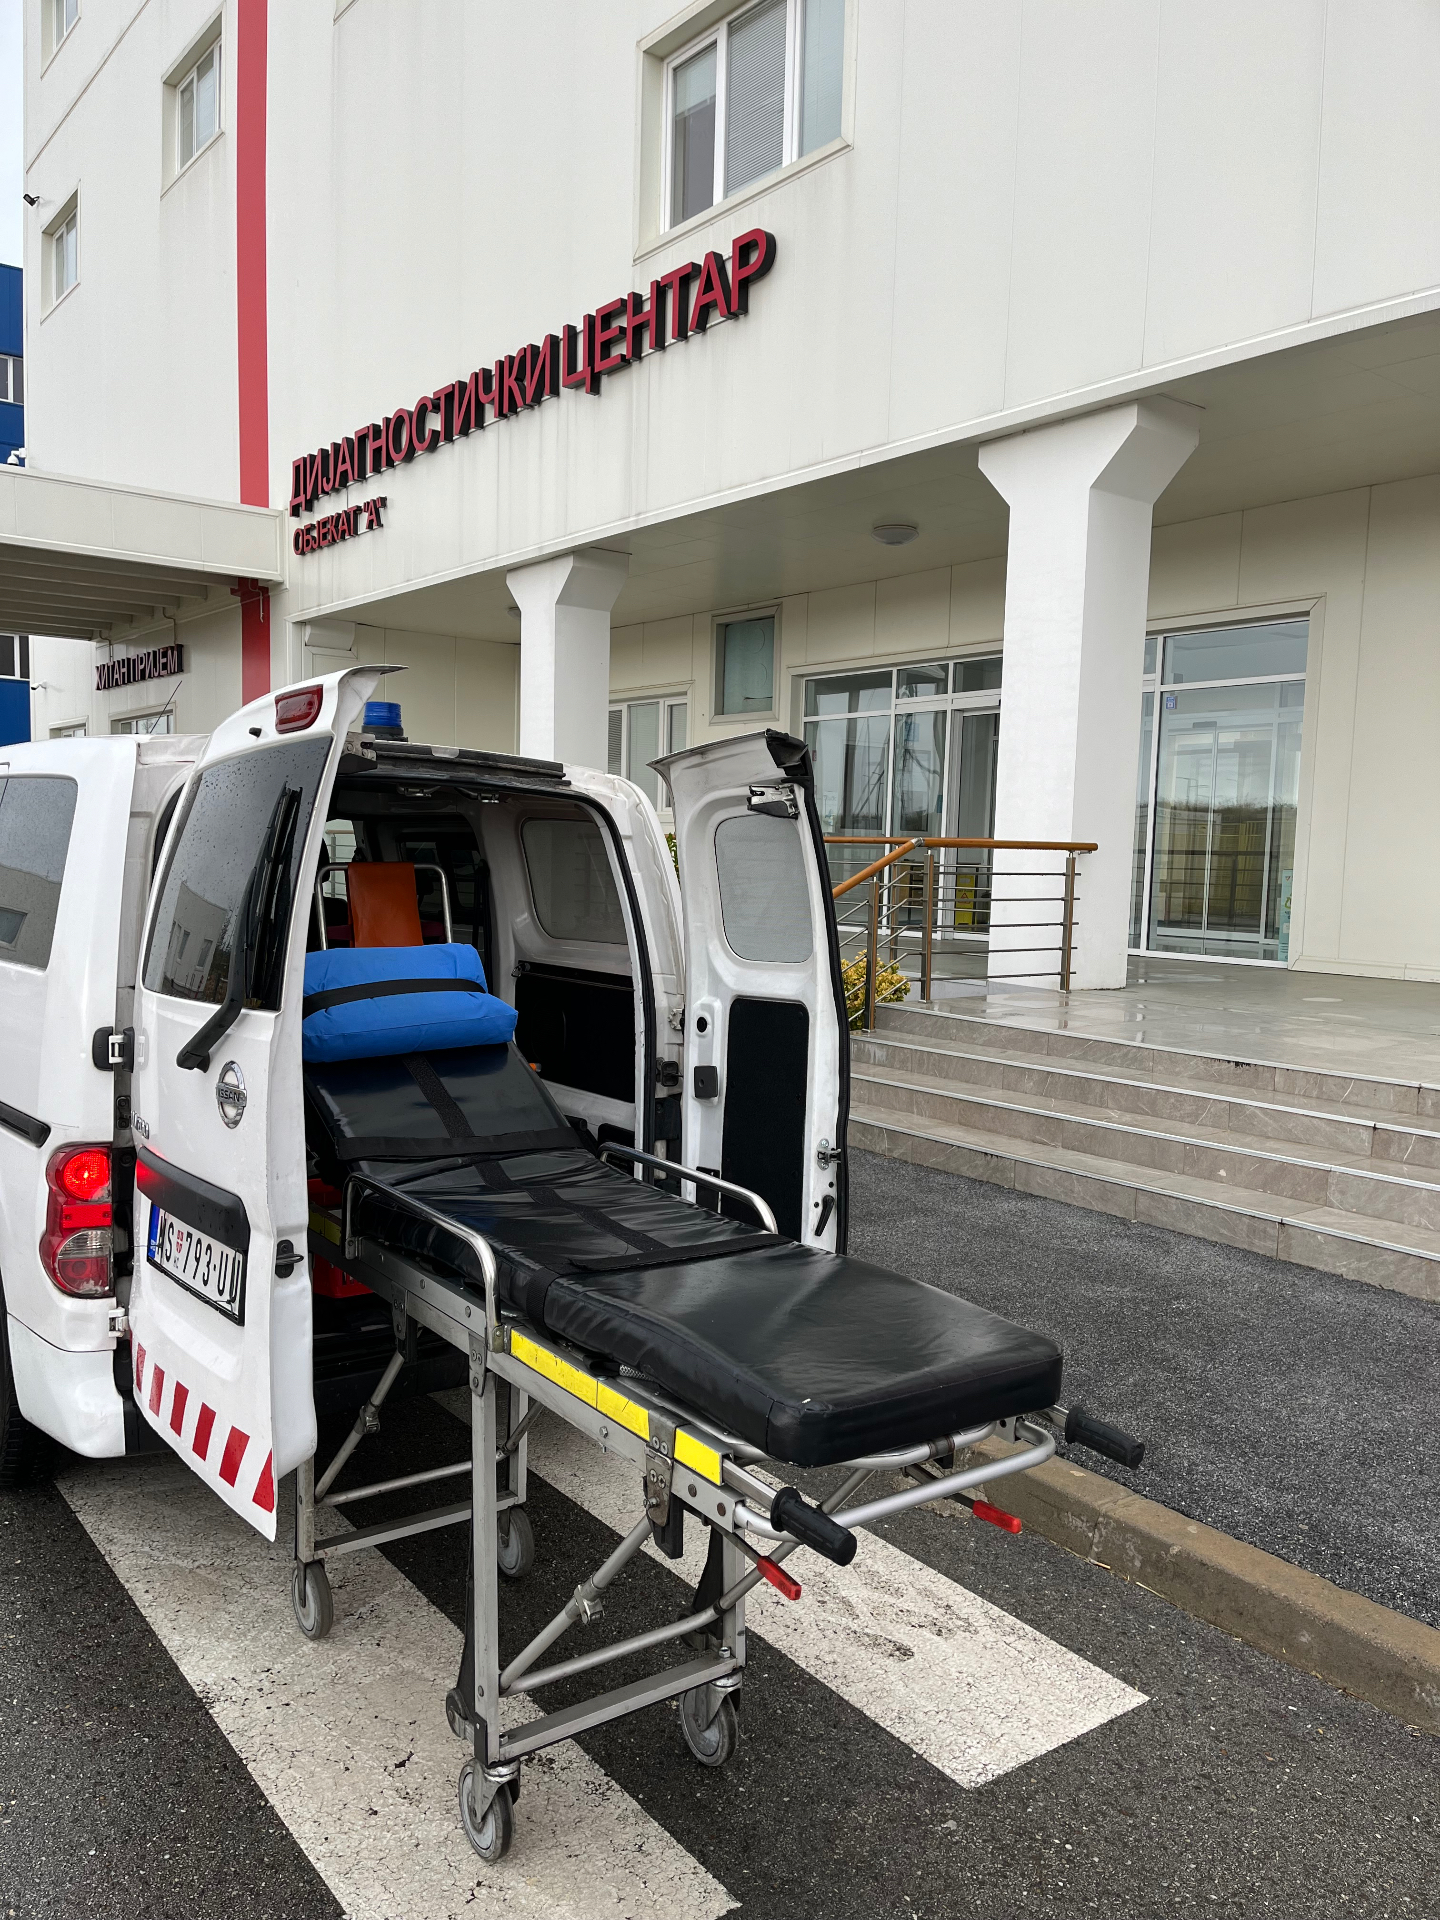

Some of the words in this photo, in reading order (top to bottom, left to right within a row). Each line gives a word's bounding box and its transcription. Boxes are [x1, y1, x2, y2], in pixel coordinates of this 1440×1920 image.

[289, 333, 560, 517] ДИЈАГНОСТИЧКИ
[562, 228, 777, 396] ЦЕНТАР
[293, 505, 362, 556] ОБЈЕКАТ
[129, 643, 184, 682] ПРИЈЕМ
